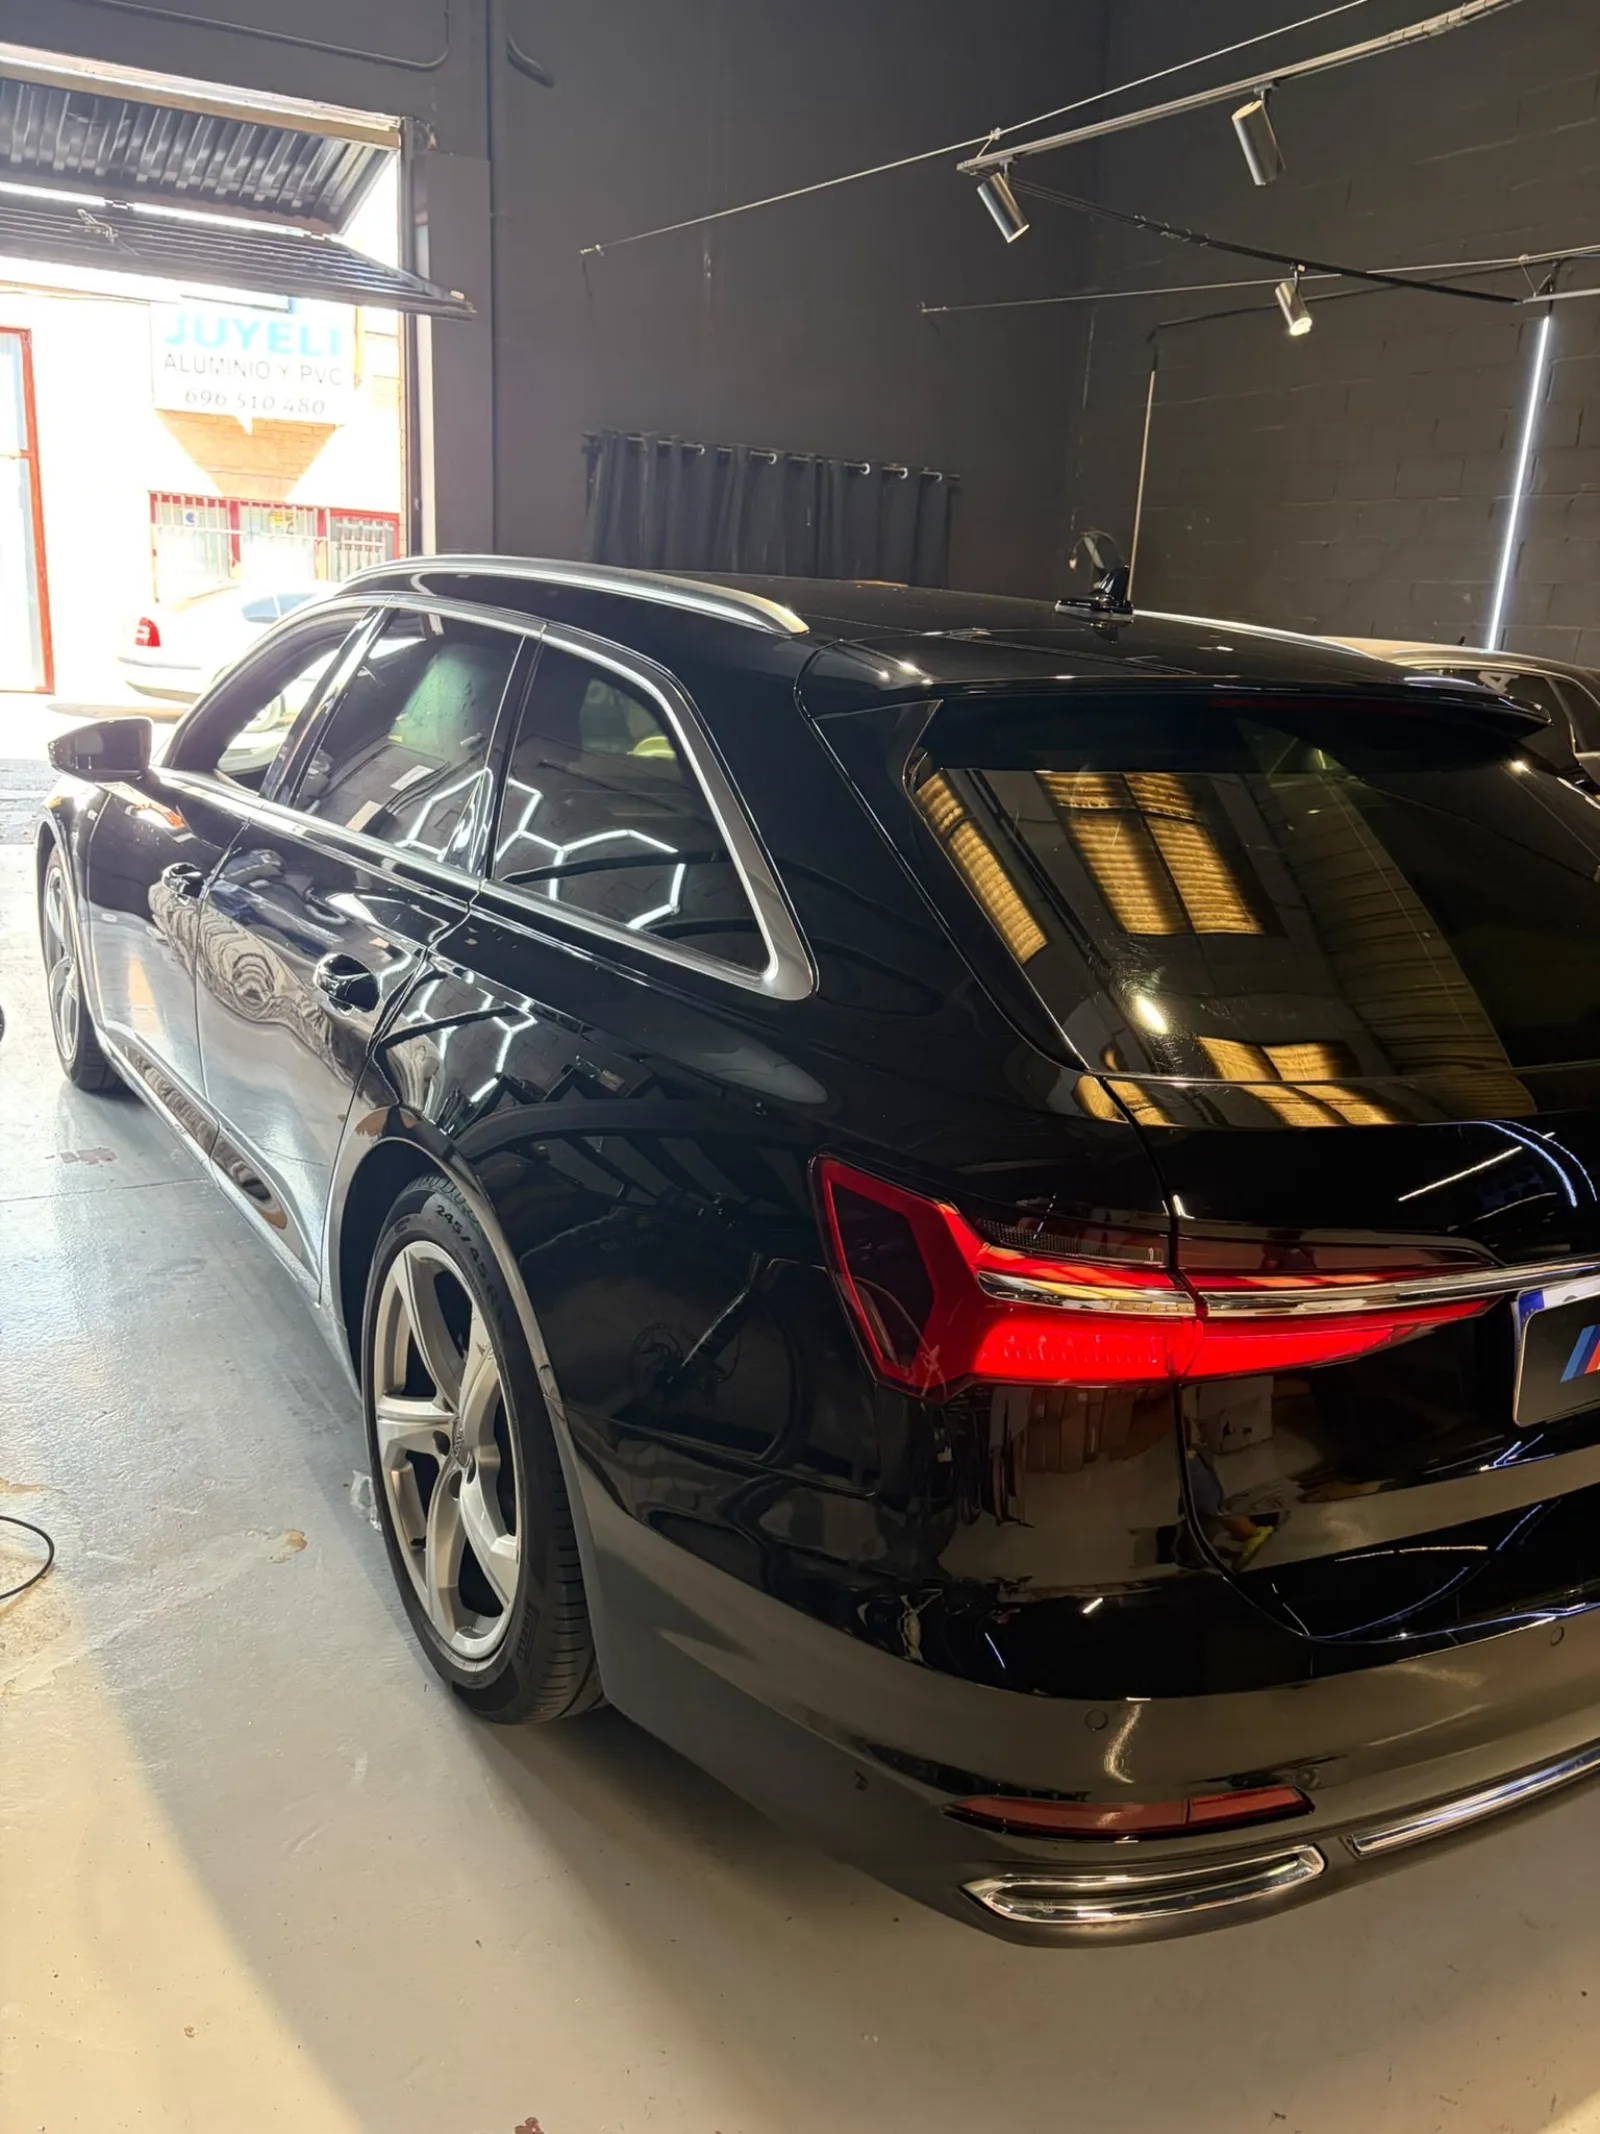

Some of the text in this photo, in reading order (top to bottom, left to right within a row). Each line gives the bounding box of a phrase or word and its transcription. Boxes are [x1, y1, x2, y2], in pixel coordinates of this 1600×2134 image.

[163, 312, 341, 358] JUYELI
[163, 352, 343, 387] ALUMINIO Y PVC
[184, 387, 326, 416] 696 510 480
